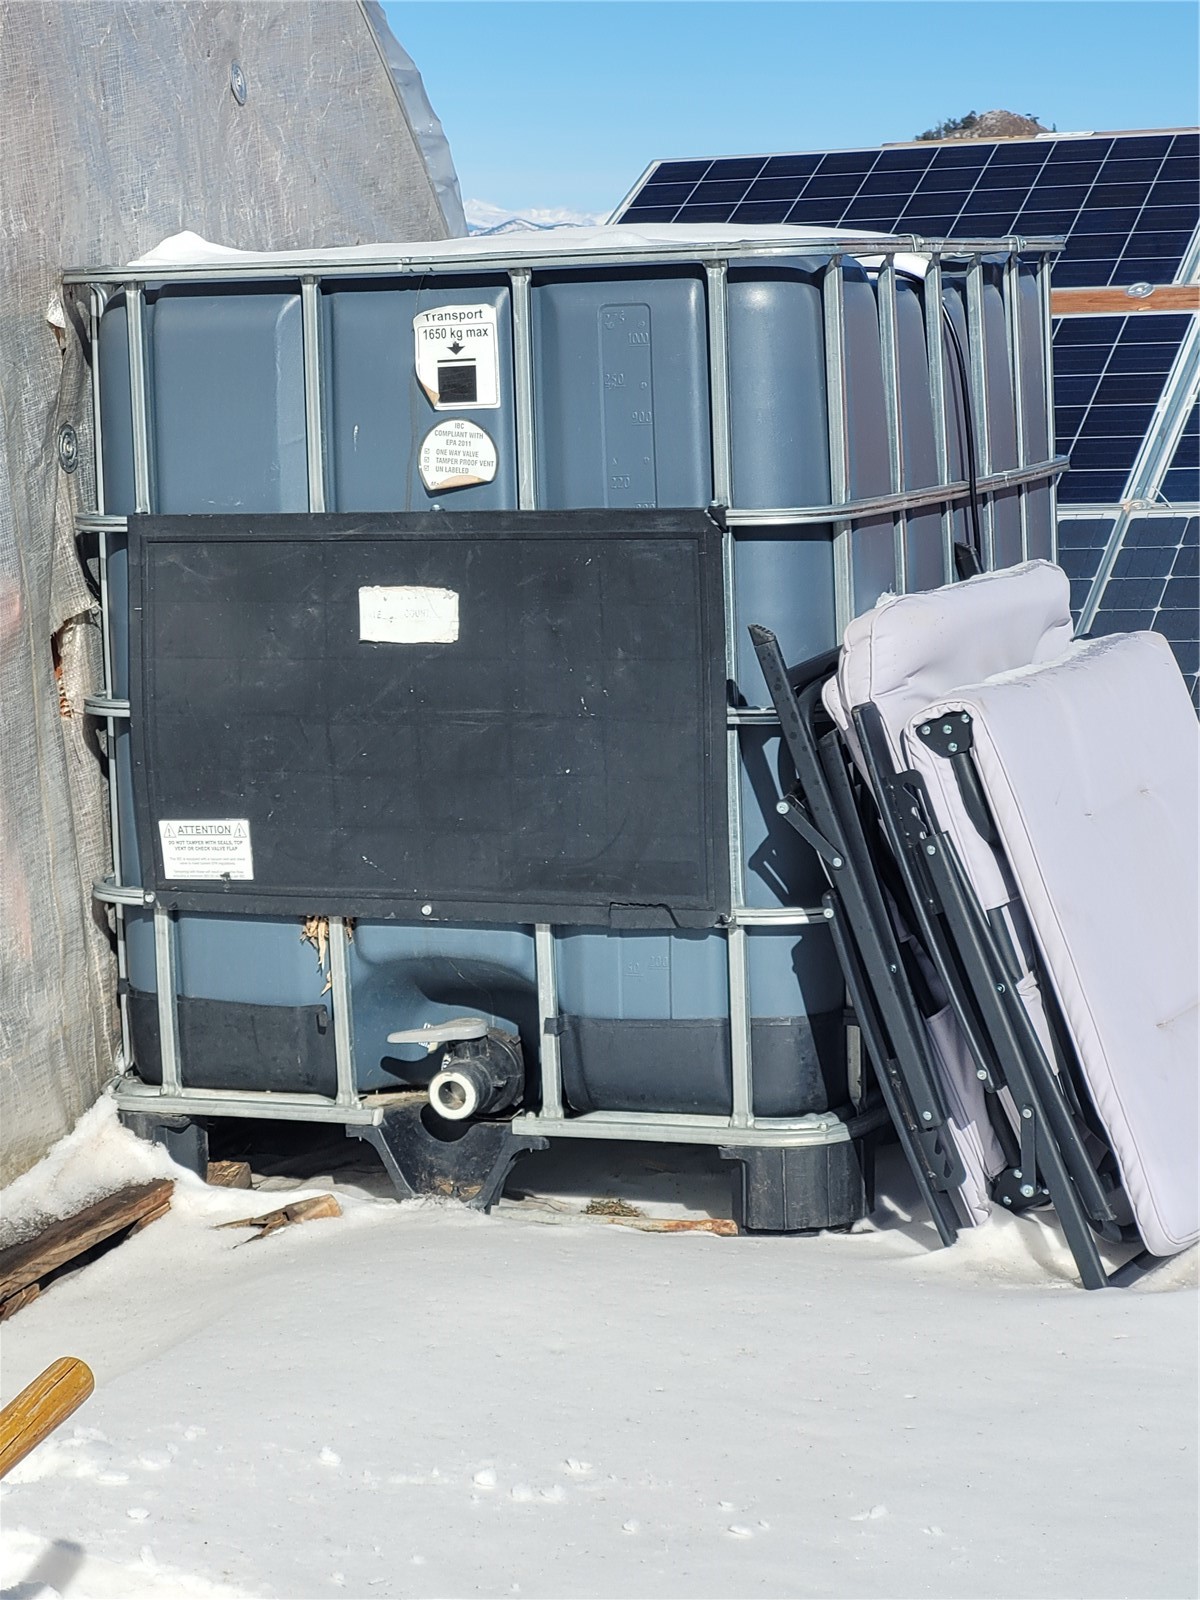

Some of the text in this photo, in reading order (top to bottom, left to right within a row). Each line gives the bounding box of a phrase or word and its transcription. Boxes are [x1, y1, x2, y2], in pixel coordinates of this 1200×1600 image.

[423, 309, 483, 323] Transport
[423, 327, 489, 341] 1650 kg max
[454, 422, 465, 430] IBC
[434, 429, 484, 440] COMPLIANT WITH
[435, 448, 448, 456] ONE
[436, 457, 494, 468] TAMPER PROOF VENT
[444, 466, 469, 474] LABELED
[178, 826, 231, 834] ATTENTION
